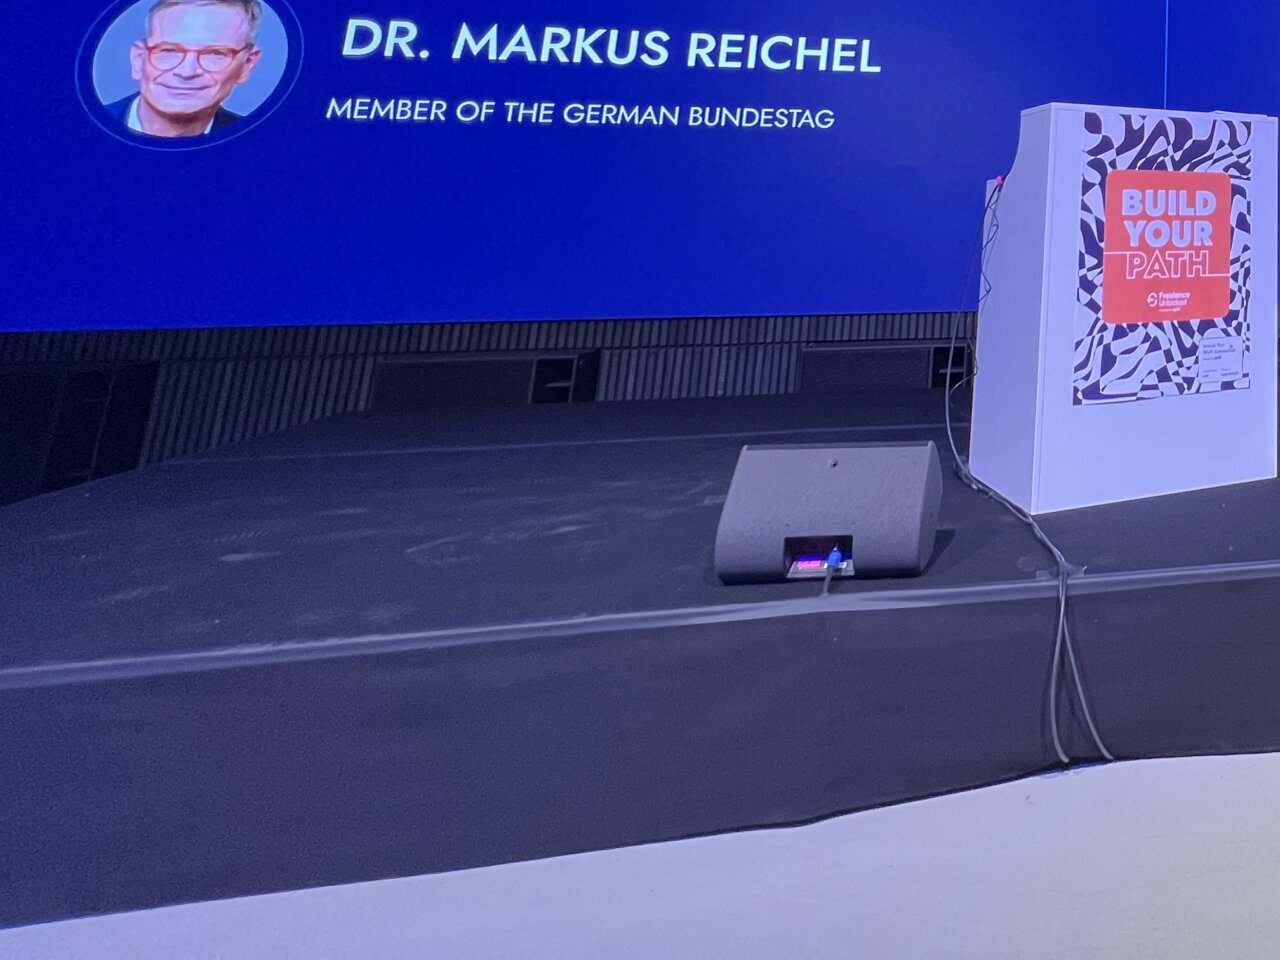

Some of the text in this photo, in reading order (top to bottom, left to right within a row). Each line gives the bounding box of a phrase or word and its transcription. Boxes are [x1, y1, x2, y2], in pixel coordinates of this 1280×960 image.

[341, 18, 882, 73] DR. MARKUS REICHEL
[325, 97, 836, 129] MEMBER OF THE GERMAN BUNDESTAG
[1121, 189, 1216, 216] BUILD
[1123, 220, 1213, 248] YOUR
[1126, 249, 1210, 280] PATH
